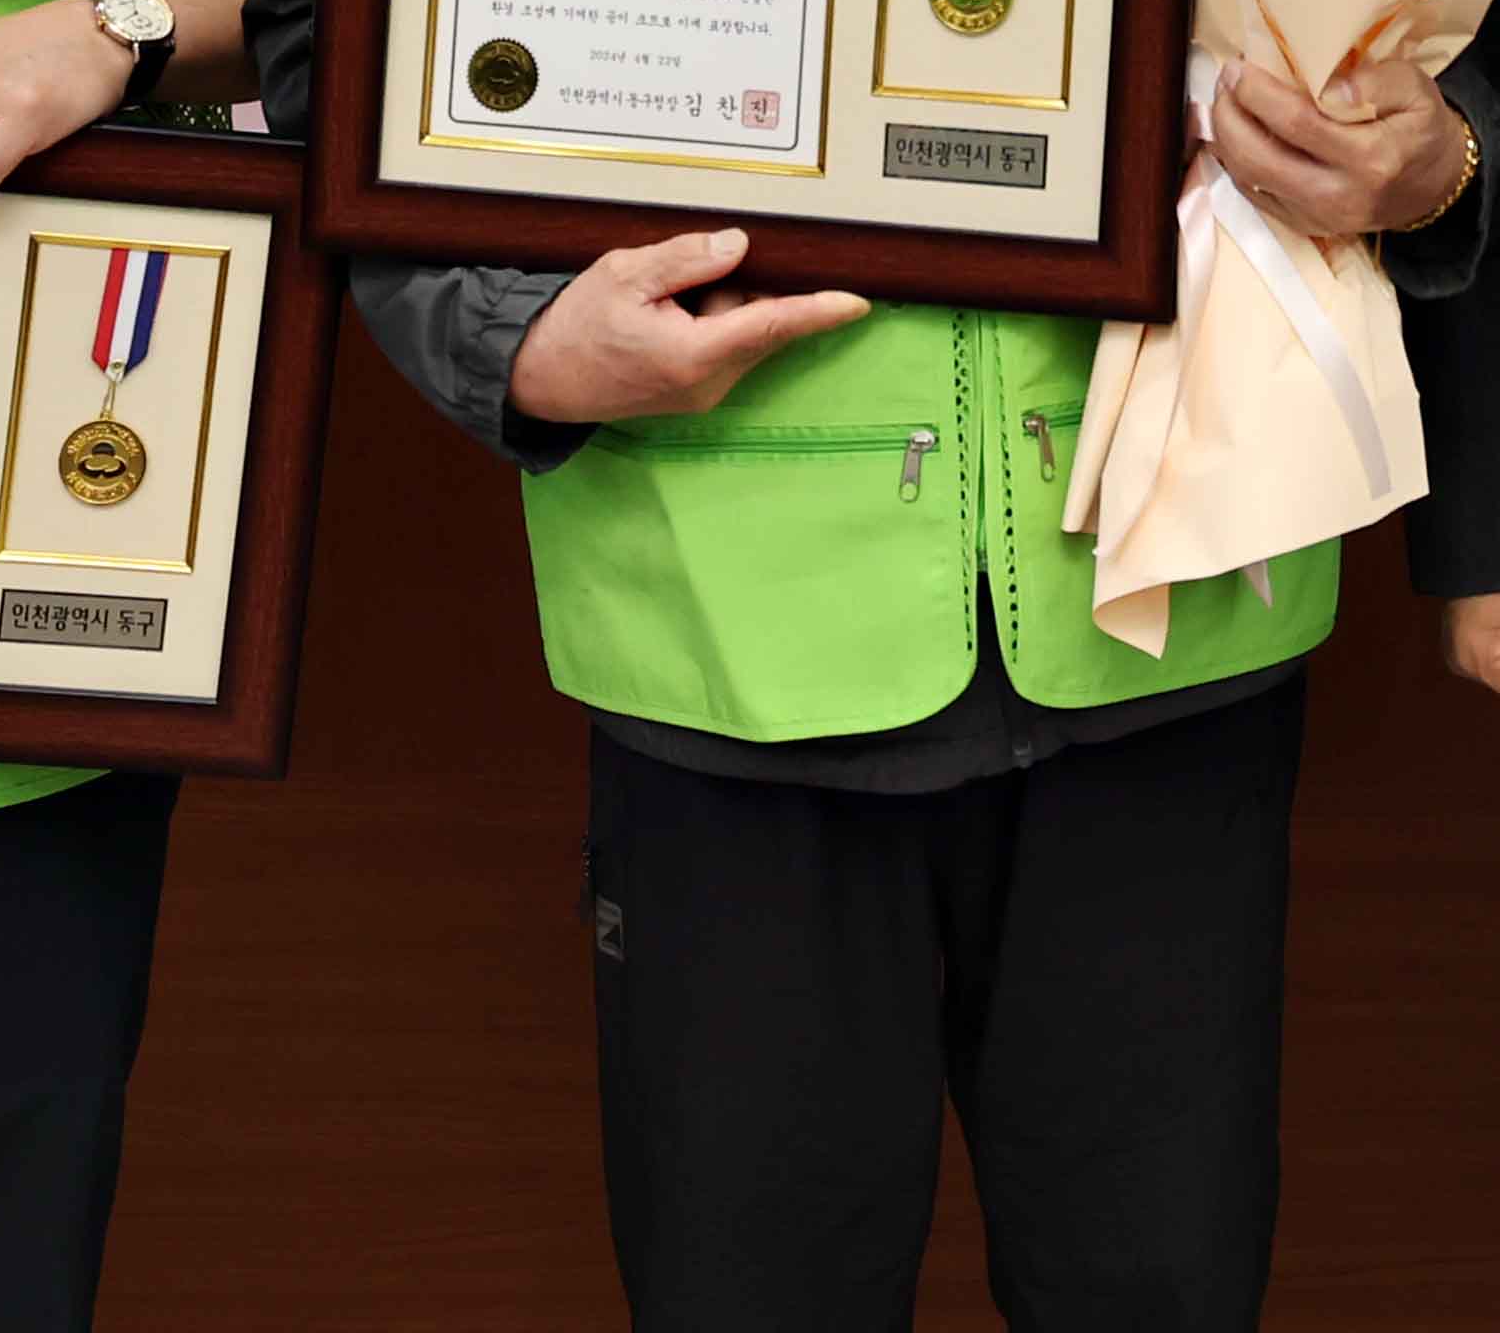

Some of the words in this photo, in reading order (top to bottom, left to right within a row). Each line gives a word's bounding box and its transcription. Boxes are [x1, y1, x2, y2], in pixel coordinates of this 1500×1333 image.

[895, 138, 991, 170] 인천광역시
[1000, 145, 1037, 174] 동구
[11, 602, 110, 633] 인천광역시
[117, 609, 156, 638] 동구
